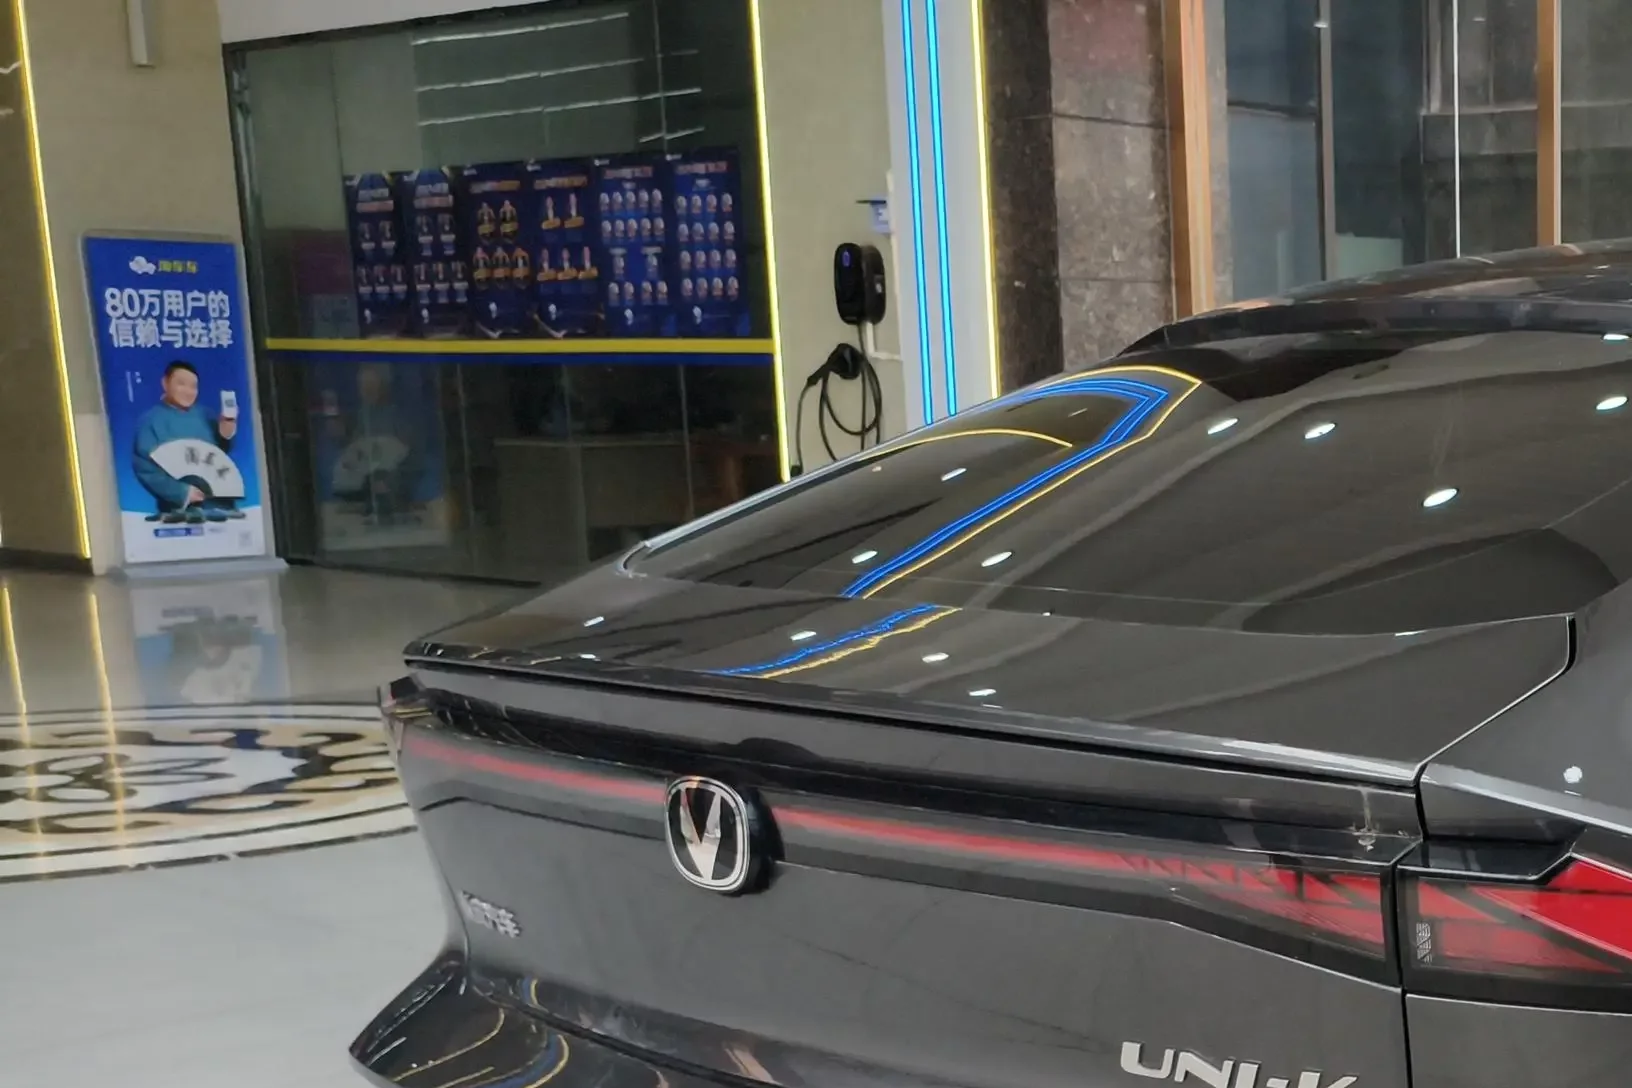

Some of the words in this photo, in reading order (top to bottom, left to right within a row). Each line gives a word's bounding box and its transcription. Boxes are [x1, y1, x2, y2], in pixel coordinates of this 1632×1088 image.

[105, 287, 230, 318] 80万用户的
[109, 317, 233, 348] 信赖与选择
